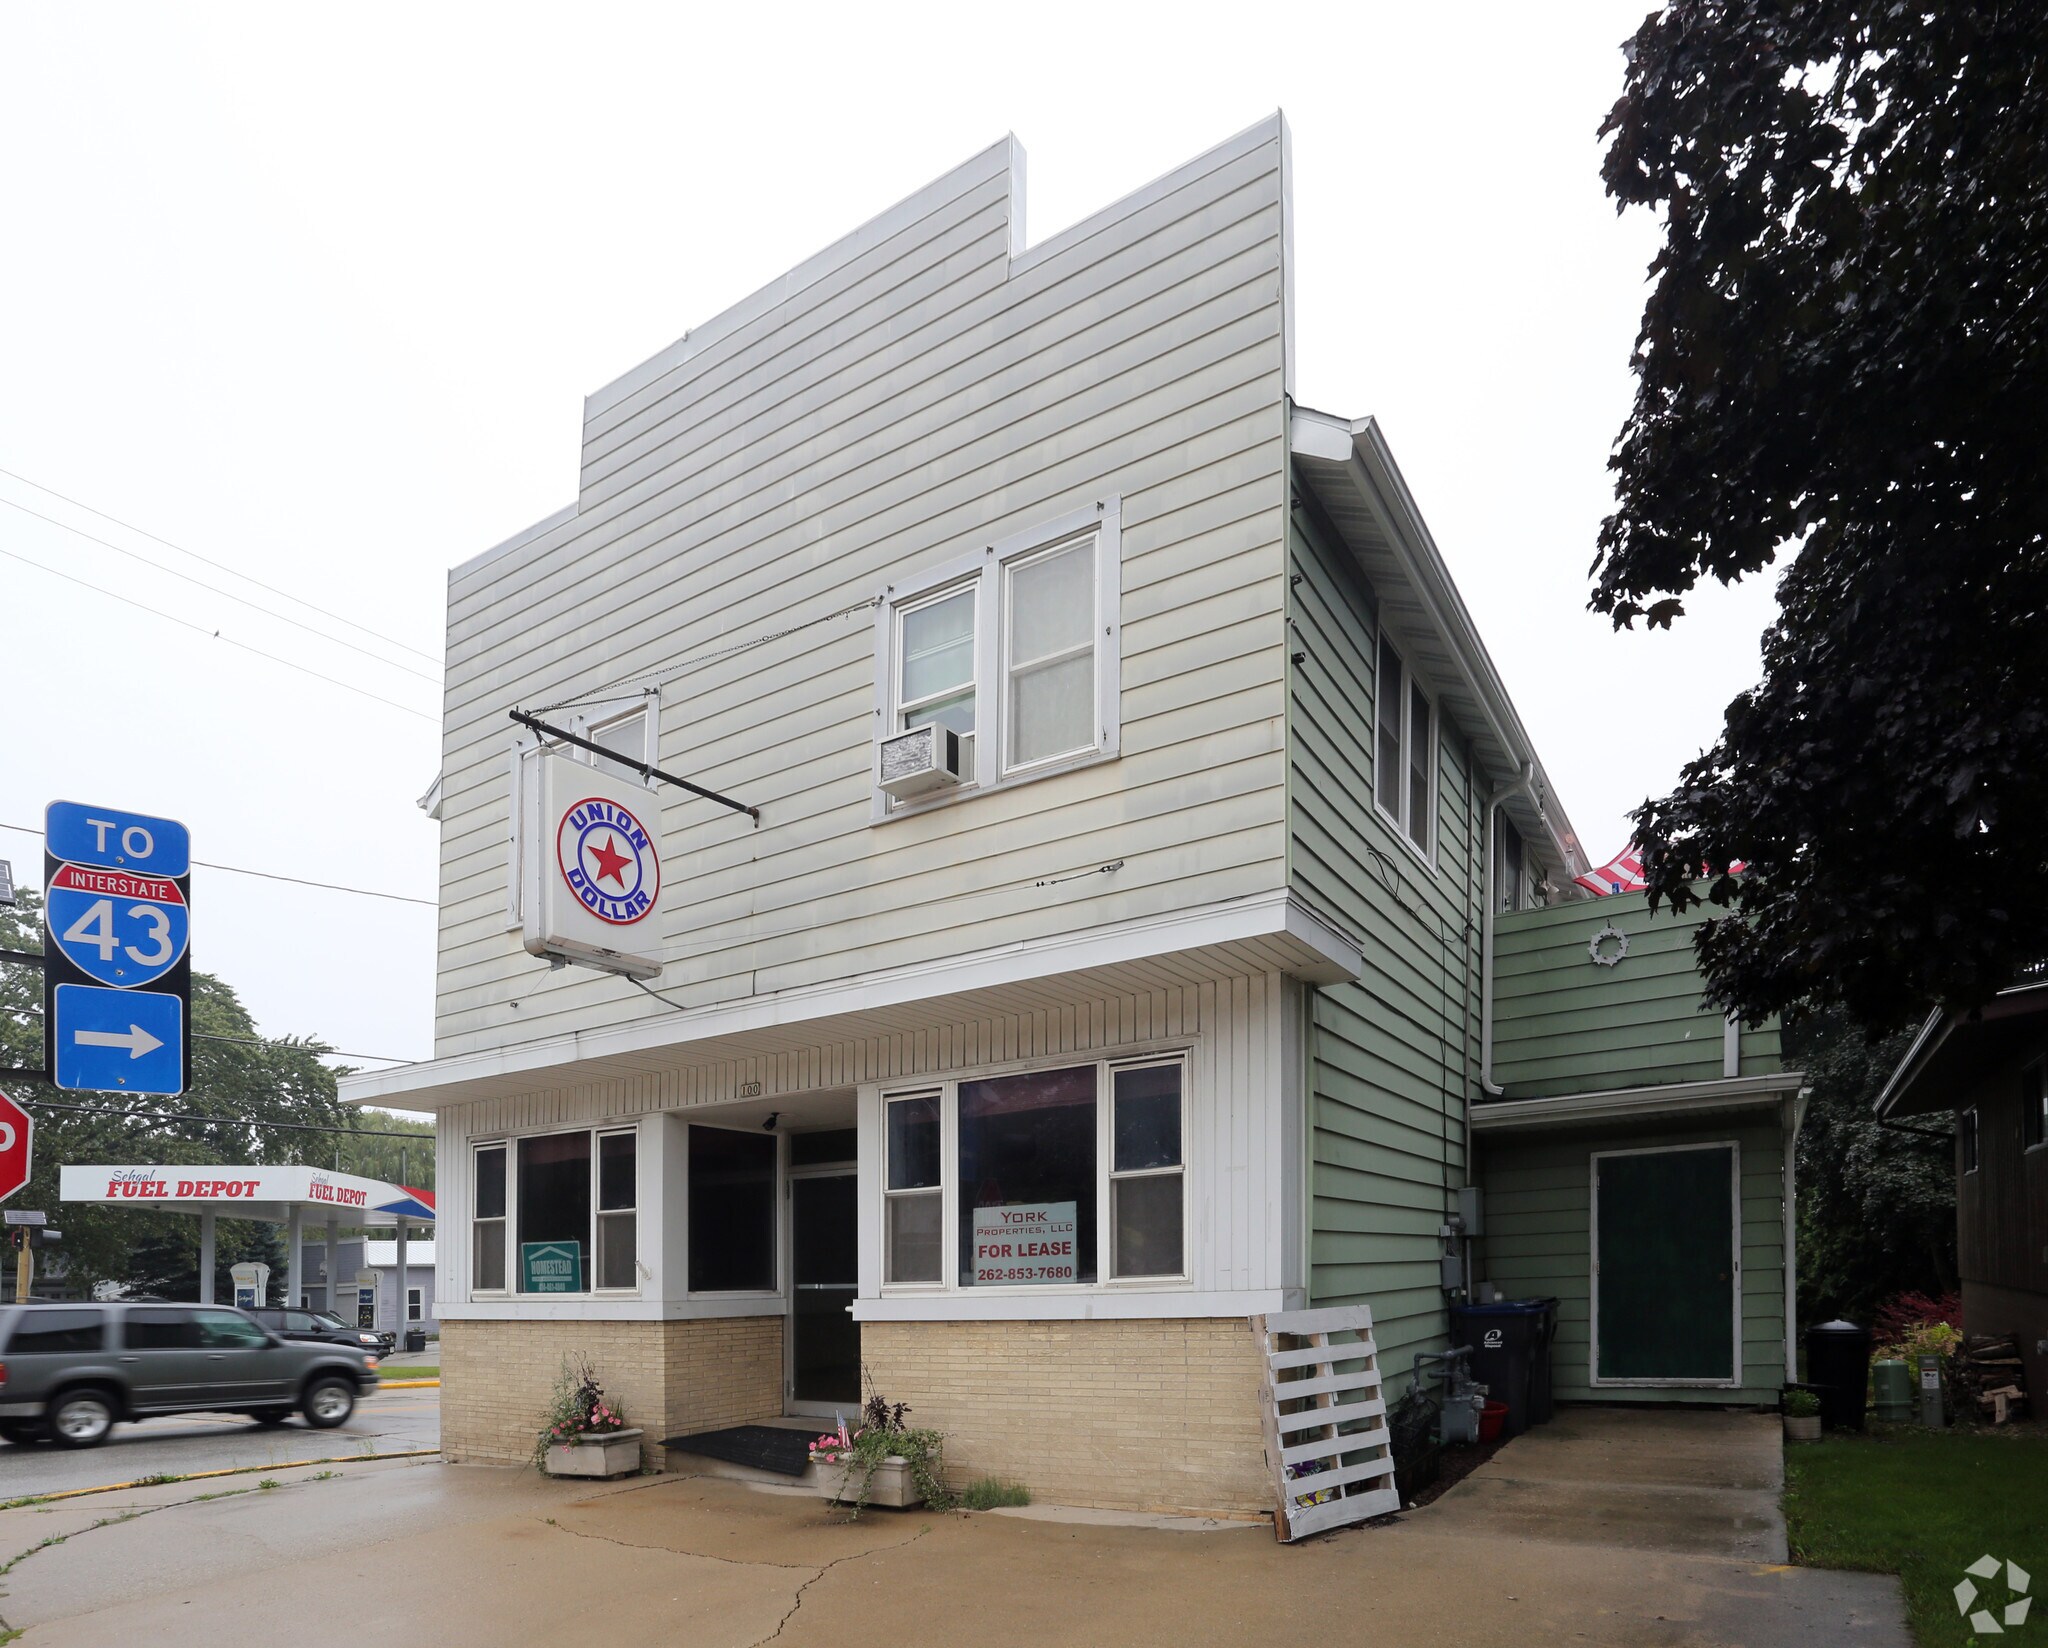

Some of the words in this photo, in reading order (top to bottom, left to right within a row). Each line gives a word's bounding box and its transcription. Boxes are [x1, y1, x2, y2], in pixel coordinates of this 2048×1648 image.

[569, 802, 649, 851] UNION
[86, 818, 154, 859] TO
[70, 872, 168, 899] INTERSTATE
[567, 867, 651, 920] DOLLAR
[63, 899, 173, 966] 43
[742, 1084, 759, 1096] 100
[111, 1169, 156, 1185] Sehgal
[106, 1181, 169, 1198] FUEL
[175, 1181, 260, 1198] DEPOT
[309, 1183, 335, 1202] FUEL
[336, 1187, 367, 1206] DEPOT
[1050, 1223, 1073, 1233] LLC
[978, 1244, 1012, 1259] FOR
[1017, 1241, 1072, 1257] LEASE
[530, 1260, 572, 1275] HOMESTEAD
[977, 1266, 1072, 1281] 262-853-7680
